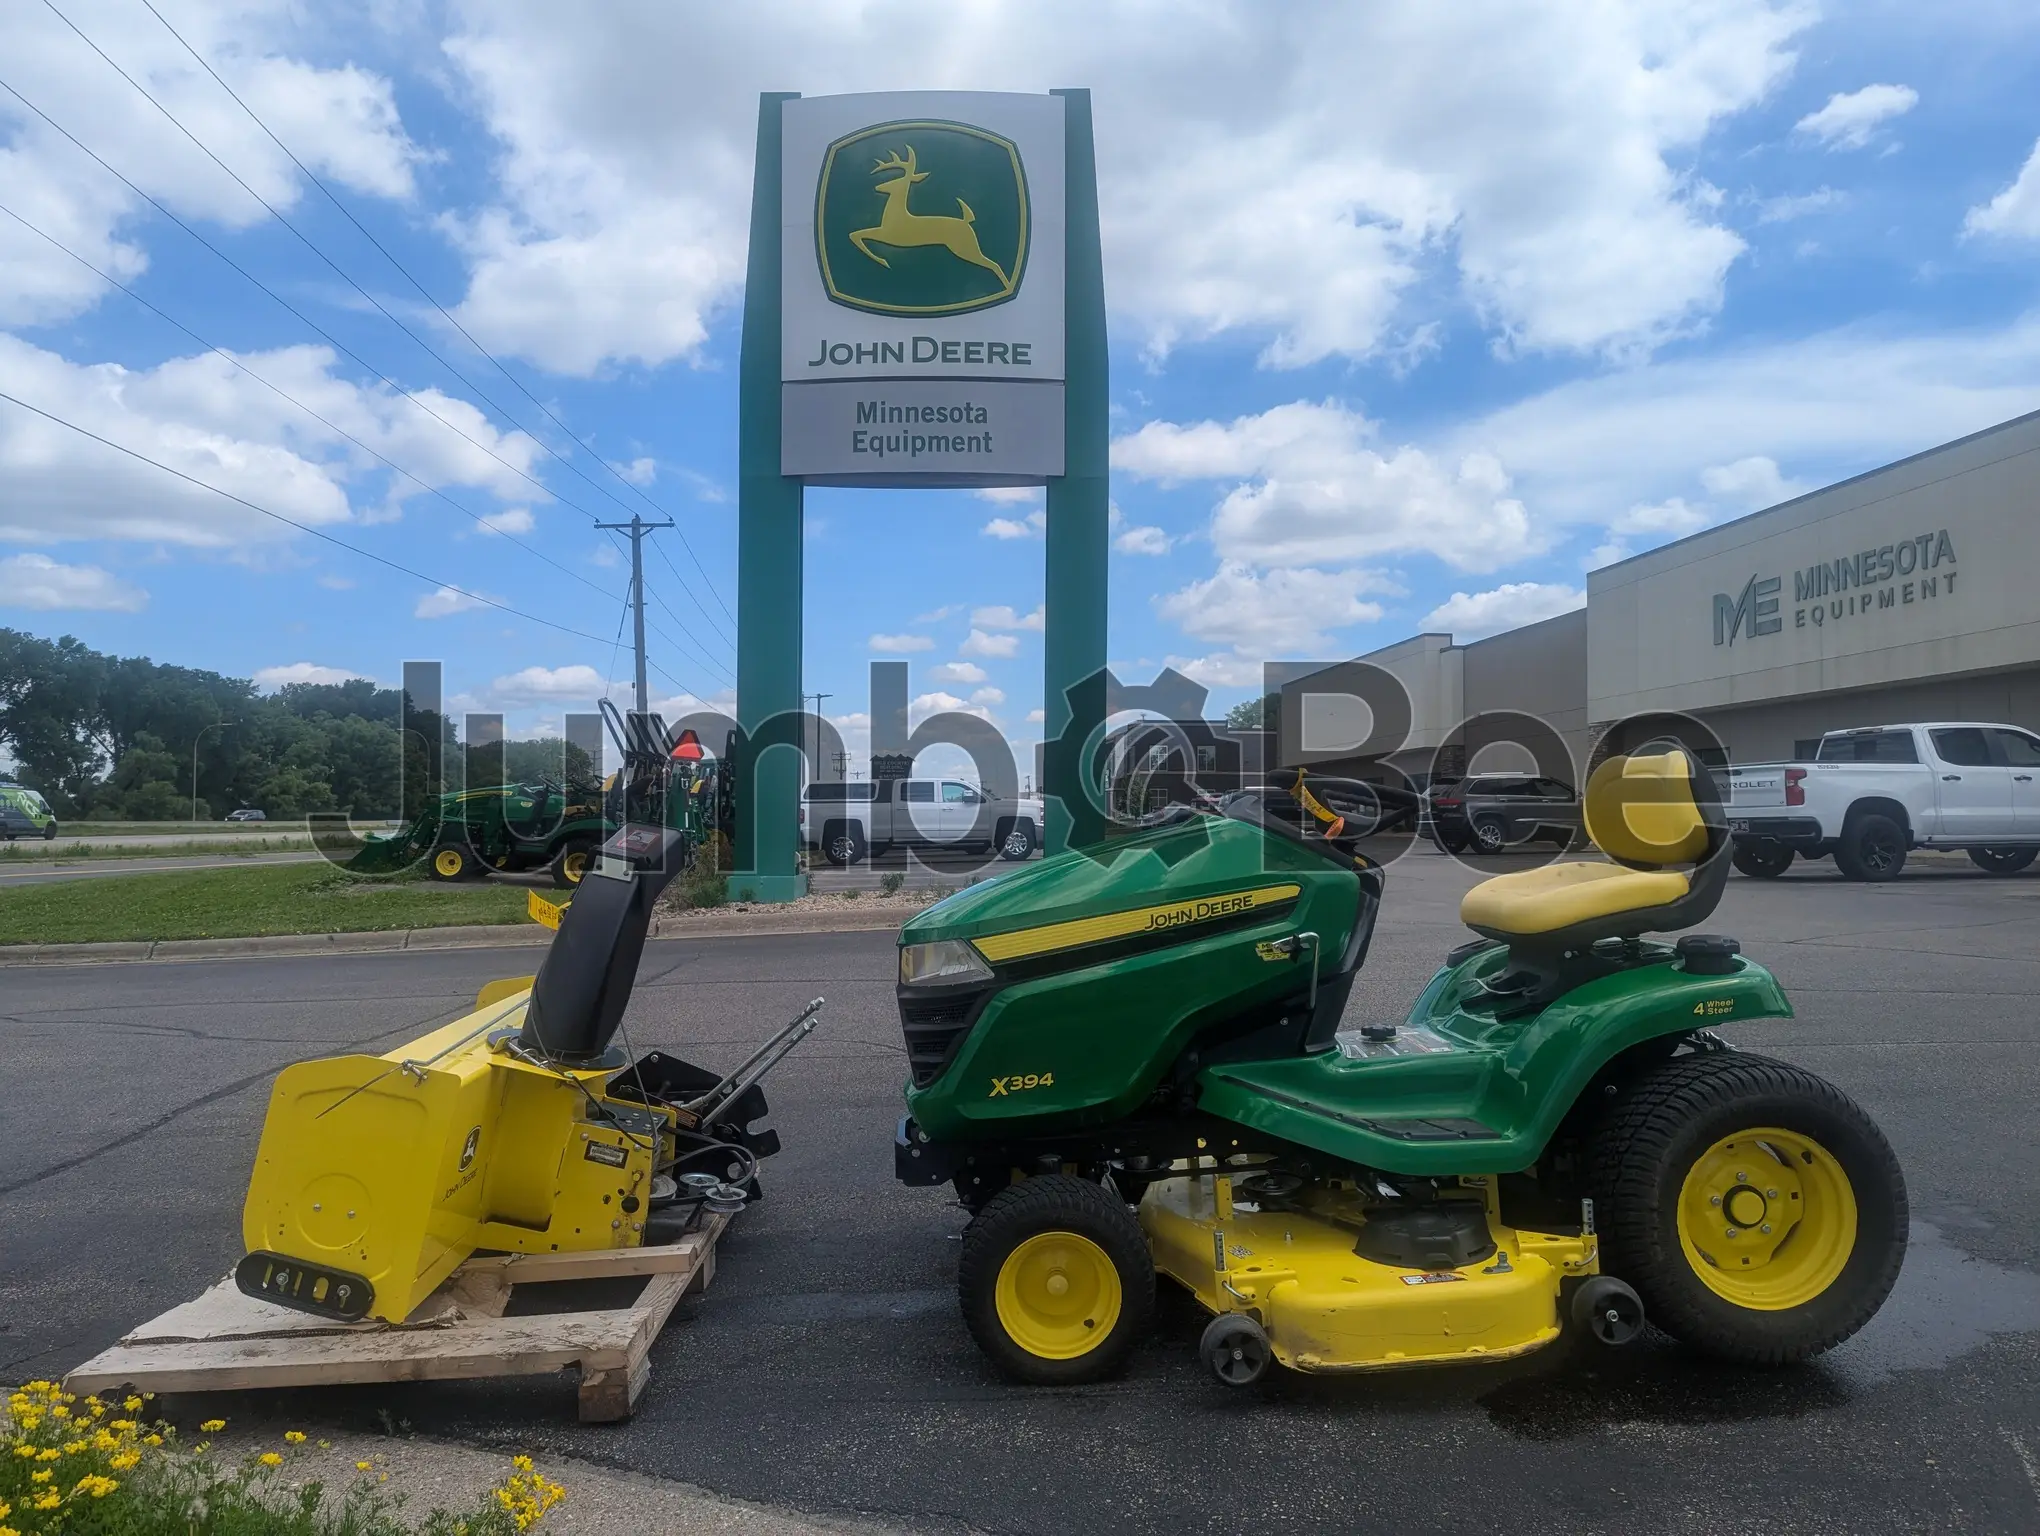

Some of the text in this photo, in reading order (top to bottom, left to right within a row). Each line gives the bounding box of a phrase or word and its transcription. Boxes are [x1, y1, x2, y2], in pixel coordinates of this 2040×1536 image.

[808, 336, 1032, 367] JOHN DEERE
[855, 400, 988, 424] Minnesota
[852, 429, 993, 458] Equipment
[1794, 528, 1957, 602] MINNESOTA
[1795, 572, 1958, 628] EQUIPMENT
[1718, 780, 1777, 790] VROLET
[1144, 894, 1254, 930] JOHN DEERE
[1693, 999, 1734, 1016] 4 Wheel
[1707, 1006, 1733, 1015] Steer
[988, 1072, 1055, 1097] X394
